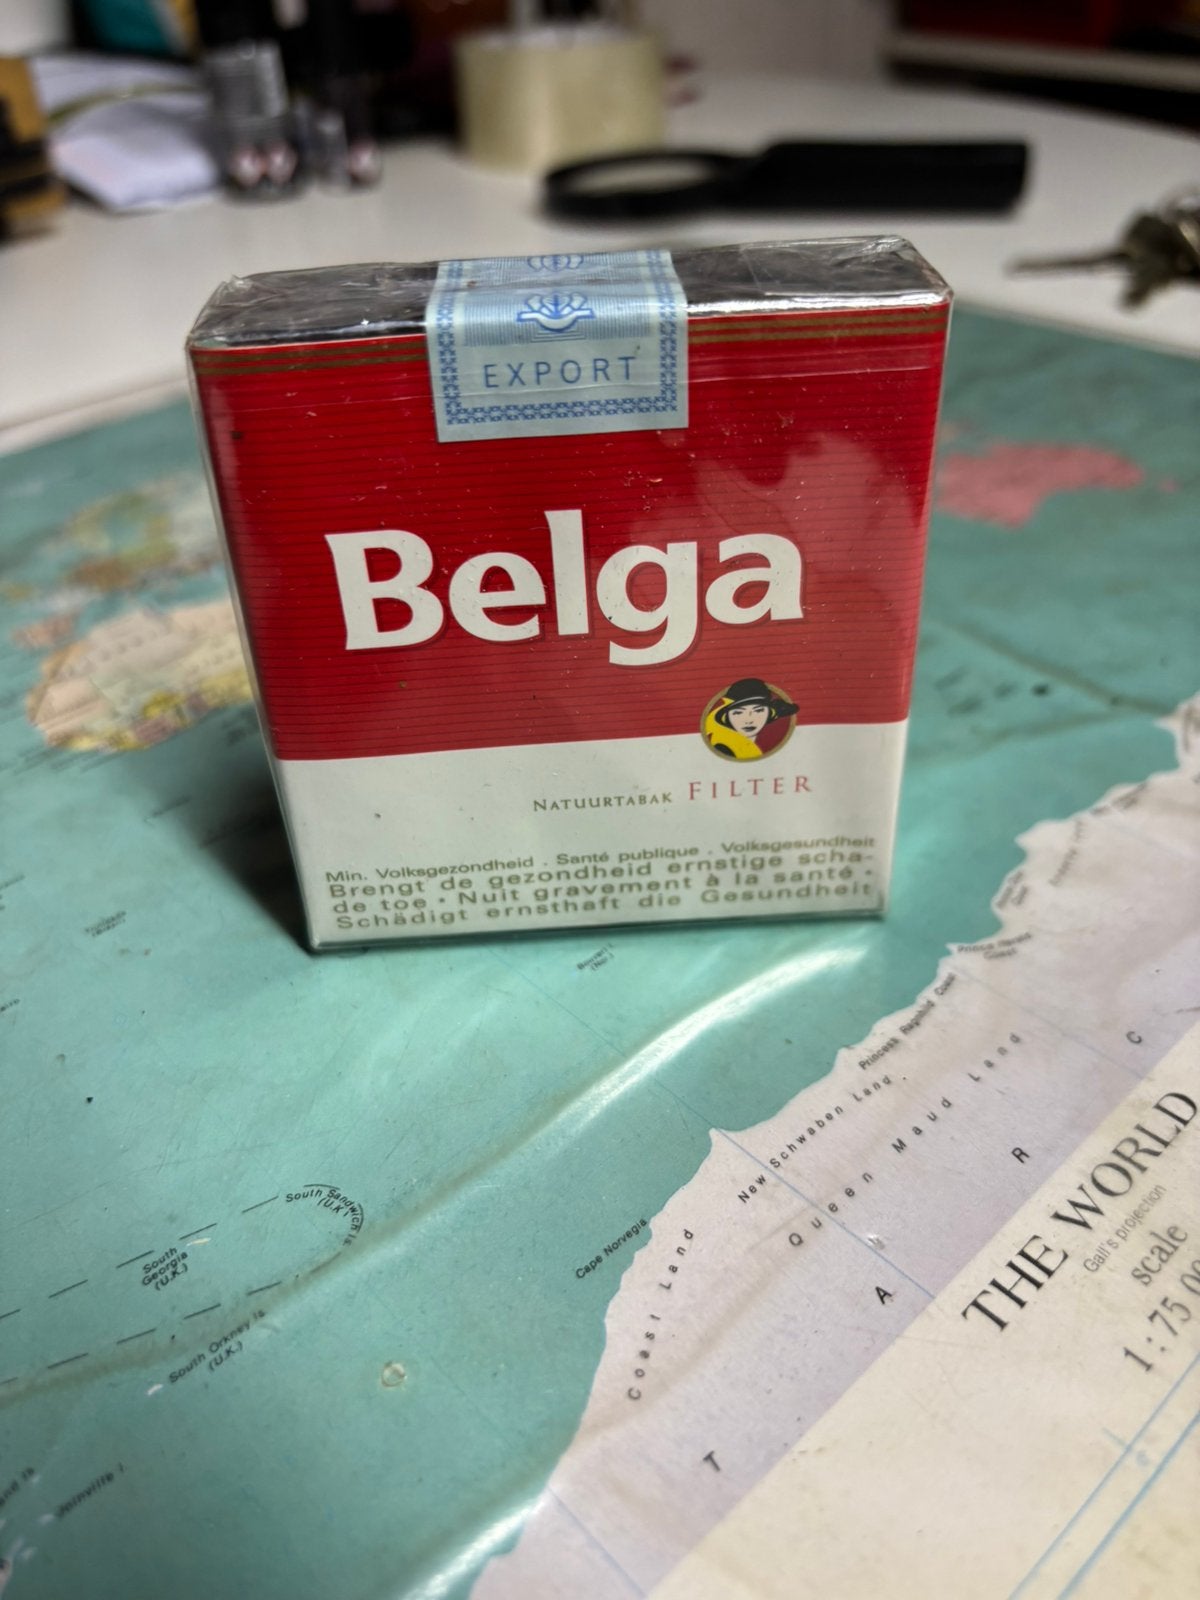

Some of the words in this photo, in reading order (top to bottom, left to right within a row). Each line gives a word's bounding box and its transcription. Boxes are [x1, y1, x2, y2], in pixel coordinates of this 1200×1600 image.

[483, 356, 636, 388] EXPORT
[324, 509, 804, 666] Belga
[689, 775, 812, 800] FILTER
[326, 870, 367, 883] Min.
[376, 856, 534, 880] Volksgezondheid
[556, 852, 609, 865] Santé
[619, 846, 699, 865] publique
[721, 835, 876, 856] Volksgesundheit
[329, 880, 424, 898] Brengt
[440, 875, 473, 891] de
[488, 864, 652, 889] gezondheid
[668, 852, 783, 874] ernstige
[798, 849, 873, 865] scha-
[333, 899, 367, 914] de
[382, 895, 427, 911] toe
[458, 888, 520, 905] Nuit
[534, 875, 692, 901] gravement
[706, 872, 720, 887] à
[735, 872, 759, 886] la
[773, 865, 853, 883] santé
[336, 909, 468, 929] Schädigt
[487, 895, 620, 918] ernsthaft
[638, 892, 682, 908] die
[701, 882, 871, 903] Gesundheit
[858, 1037, 900, 1071] Princess
[737, 1174, 768, 1204] New
[769, 1104, 844, 1169] Schwaben
[852, 1074, 892, 1103] Land
[788, 1171, 873, 1247] Queen
[892, 1096, 953, 1155] Maud
[967, 1032, 1022, 1083] Land
[286, 1187, 323, 1203] South
[327, 1188, 362, 1233] Sandwich
[961, 1234, 1069, 1332] THE
[1051, 1091, 1198, 1232] WORLD
[1083, 1238, 1120, 1273] Gall's
[1115, 1184, 1167, 1242] projection
[142, 1252, 188, 1286] Georgia
[143, 1247, 178, 1274] South
[575, 1254, 604, 1280] Cape
[603, 1217, 648, 1257] Norvegia
[659, 1228, 694, 1291] Land
[1131, 1225, 1188, 1287] scale
[168, 1353, 207, 1383] South
[208, 1321, 251, 1354] Orkney
